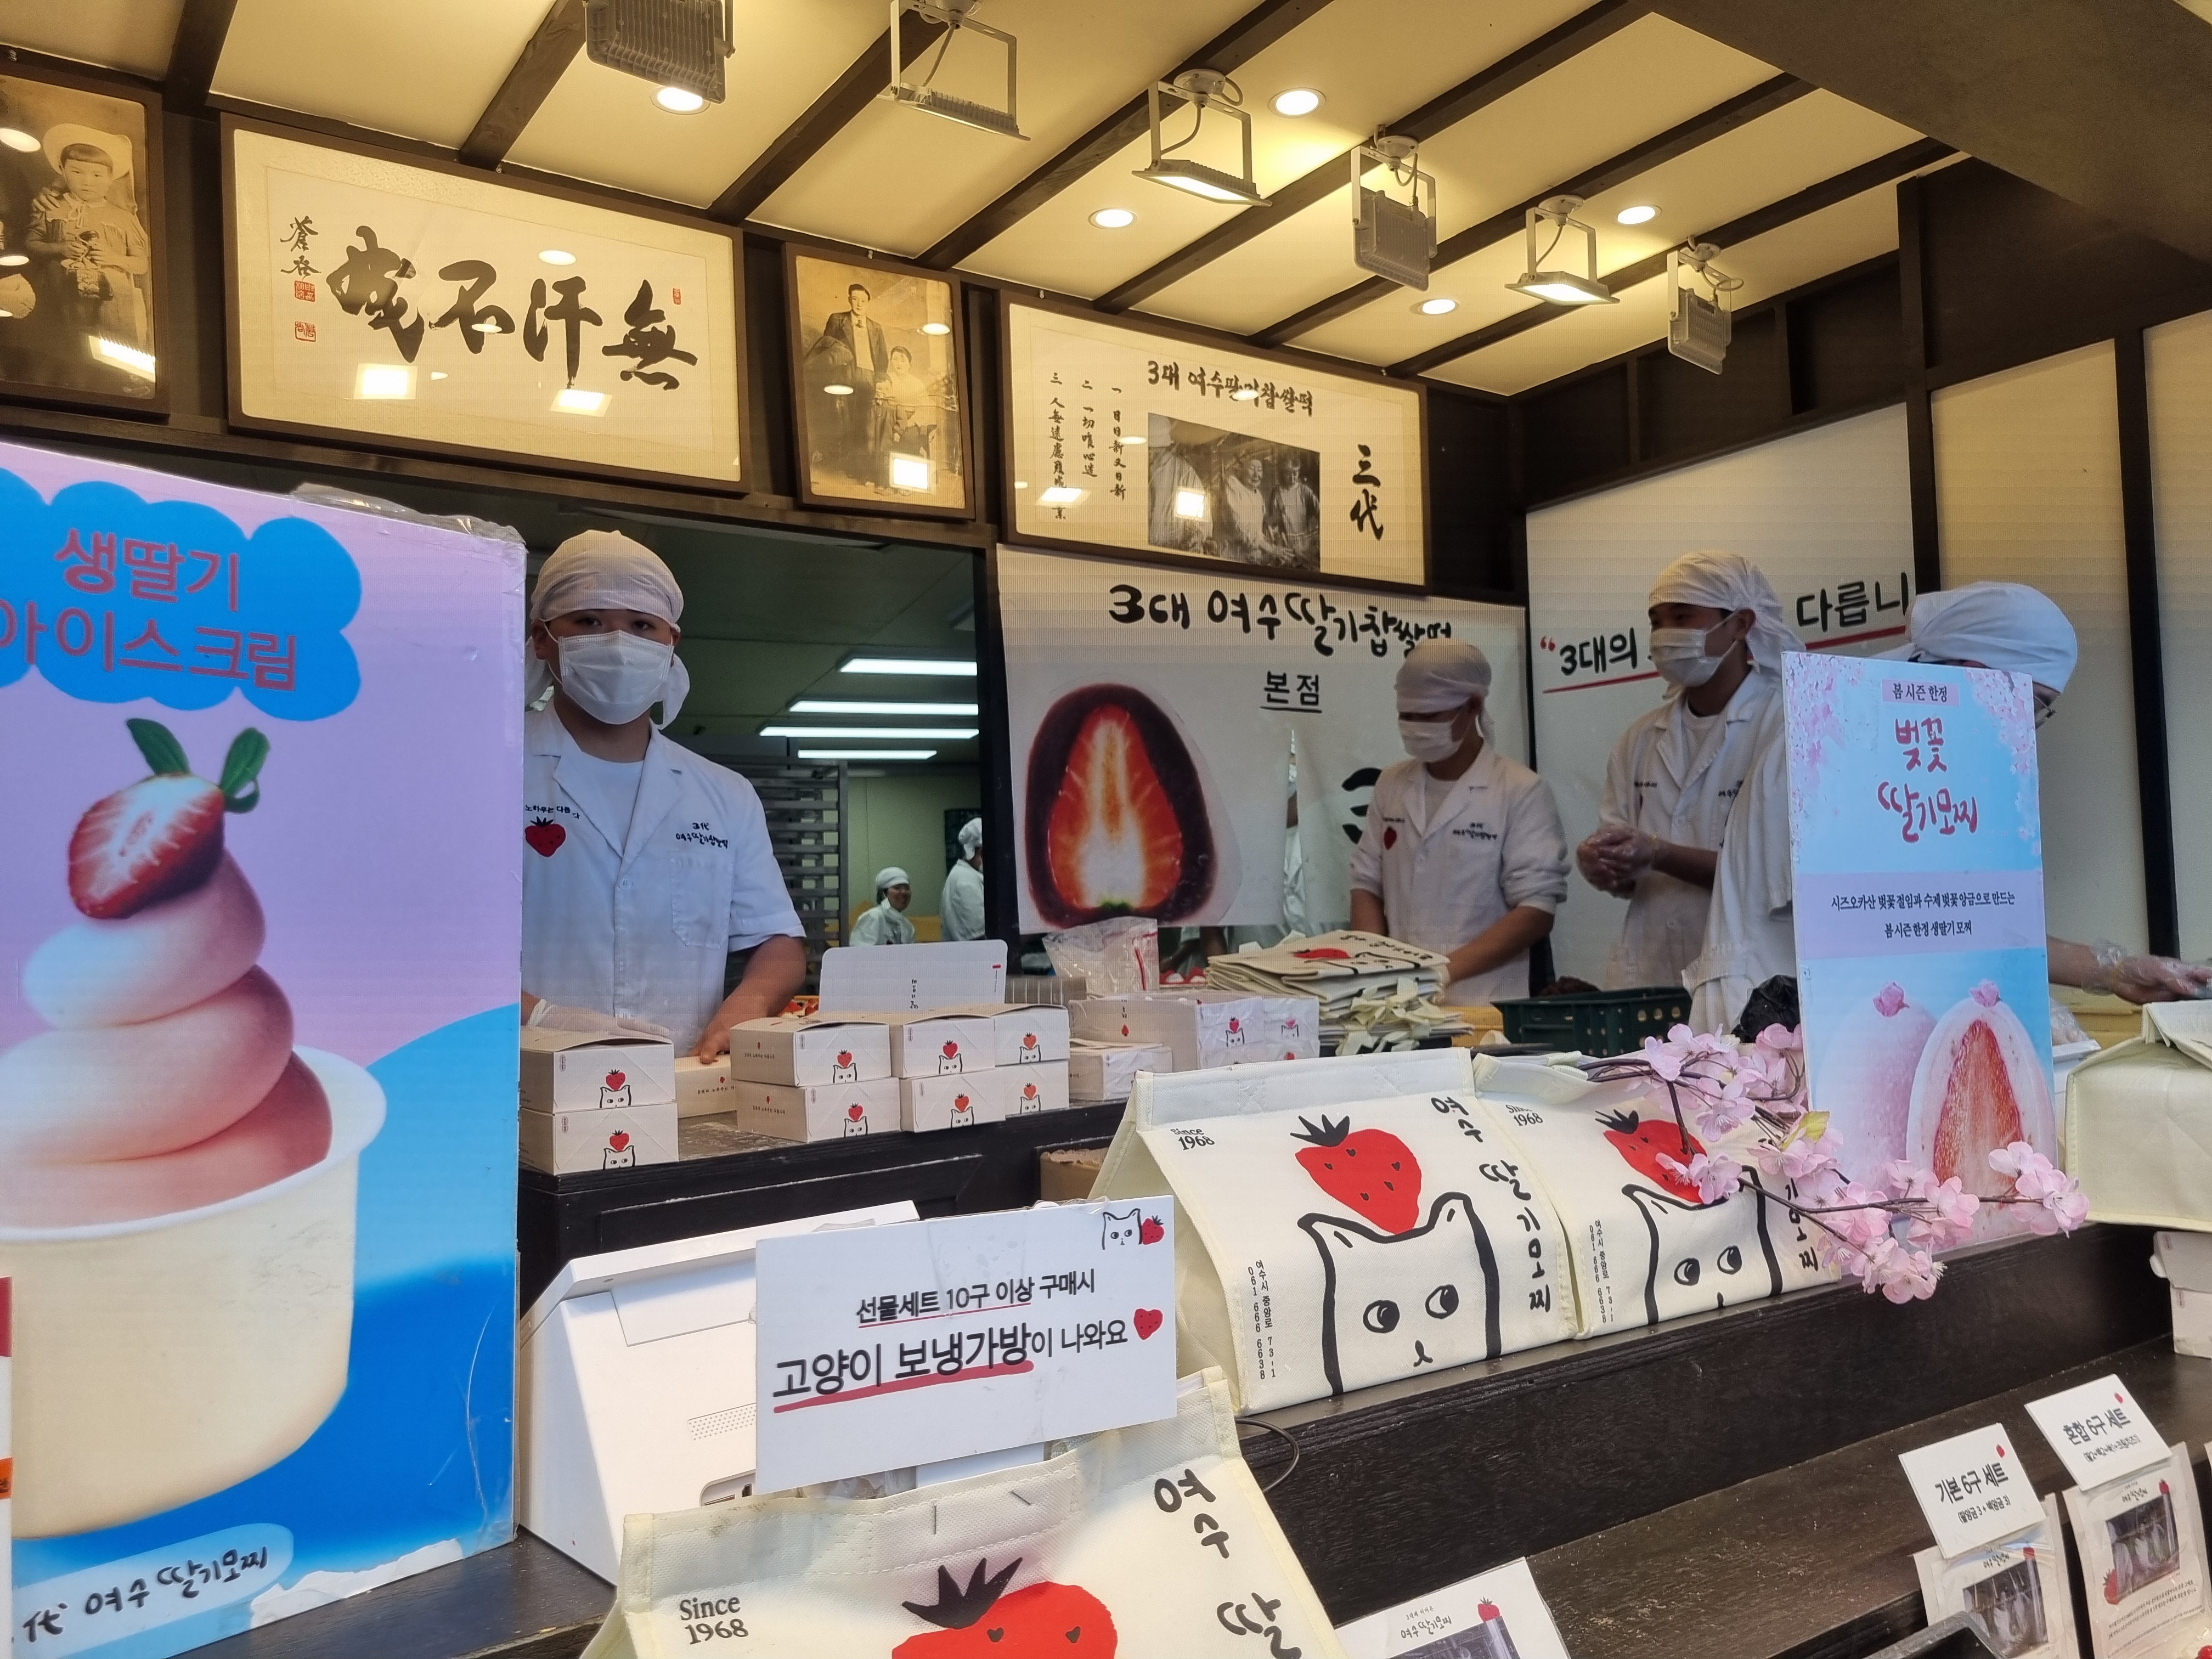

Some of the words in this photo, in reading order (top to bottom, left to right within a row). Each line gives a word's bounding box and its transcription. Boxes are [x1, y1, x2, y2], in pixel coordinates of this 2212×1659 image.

[1147, 360, 1180, 391] 3대
[54, 527, 239, 613] 생딸기
[1108, 584, 1190, 630] 3대
[0, 598, 297, 692] 아이스크림
[1263, 670, 1320, 706] 본점
[1892, 683, 1902, 702] 봄
[1905, 684, 1927, 702] 시즌
[1929, 685, 1948, 703] 한정
[1894, 717, 1948, 772] 벚꽃
[1877, 781, 1978, 844] 딸기모찌
[1831, 894, 1876, 912] 시즈오카산
[1878, 893, 1895, 911] 벚꽃
[1923, 892, 1941, 909] 수제
[1992, 890, 2016, 905] 만드는
[1884, 922, 1894, 940] 봄
[1894, 922, 1912, 938] 시즌
[1912, 921, 1929, 937] 한정
[1931, 919, 1955, 936] 생딸기
[1513, 1111, 1544, 1127] 1968
[1178, 1135, 1215, 1150] 1968
[1431, 1096, 1483, 1143] 여수
[1479, 1159, 1551, 1312] 딸기모찌
[1255, 1259, 1269, 1291] 여수시
[856, 1290, 940, 1324] 선물세트
[946, 1283, 990, 1311] 10구
[996, 1277, 1035, 1304] 이상
[1040, 1268, 1096, 1299] 구매시
[1598, 1287, 1606, 1323] 6638
[1248, 1266, 1257, 1296] 061
[1257, 1339, 1265, 1380] 6638
[772, 1342, 882, 1398] 고양이
[895, 1322, 1053, 1379] 보냉가방이
[1061, 1320, 1128, 1355] 나와요
[2085, 1415, 2108, 1436] 6구
[2104, 1408, 2131, 1429] 세트
[1934, 1476, 1964, 1504] 기본
[1960, 1469, 1982, 1494] 6구
[1982, 1462, 2009, 1488] 세트
[1154, 1468, 1230, 1559] 여수
[1976, 1505, 1983, 1516] 3
[679, 1596, 741, 1622] Since
[685, 1618, 749, 1645] 1968
